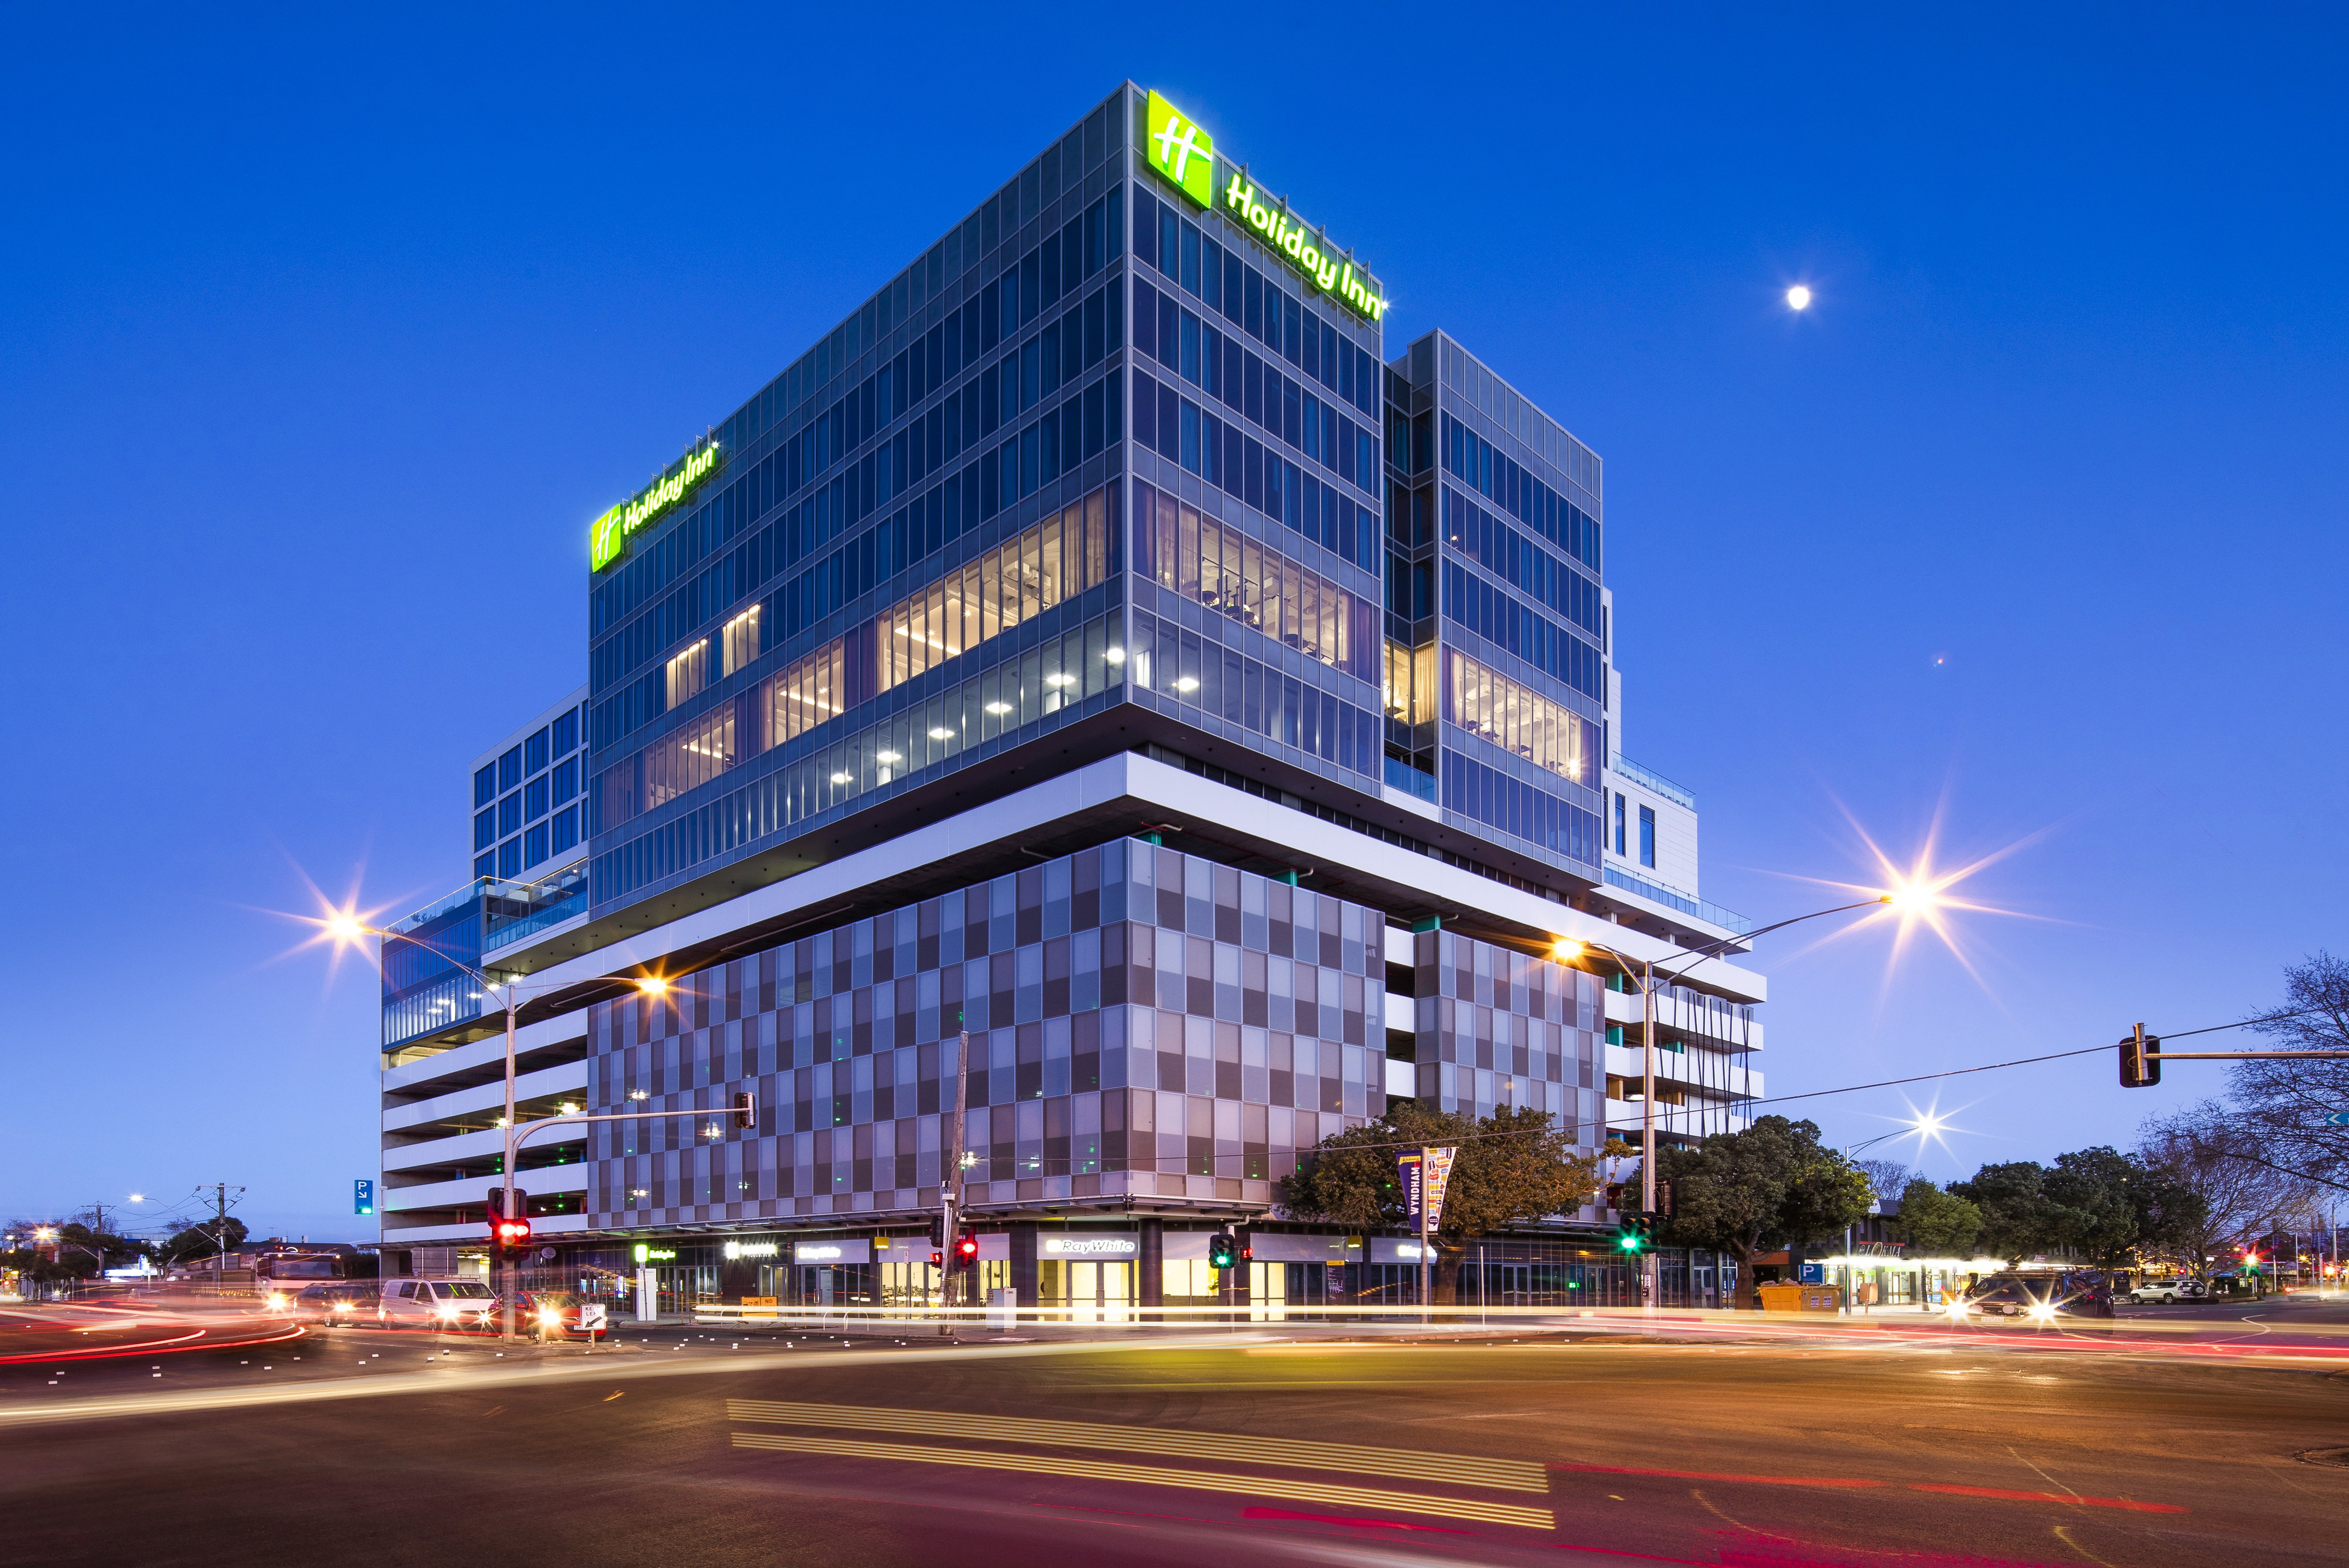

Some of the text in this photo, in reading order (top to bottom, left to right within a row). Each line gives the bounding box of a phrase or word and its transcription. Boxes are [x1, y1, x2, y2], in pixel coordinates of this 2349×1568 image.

[1227, 173, 1381, 321] Holiday Inn
[623, 448, 714, 535] Holiday Inn
[358, 1181, 367, 1190] P
[1410, 1167, 1420, 1215] WYNDHAM
[1803, 1265, 1814, 1276] P
